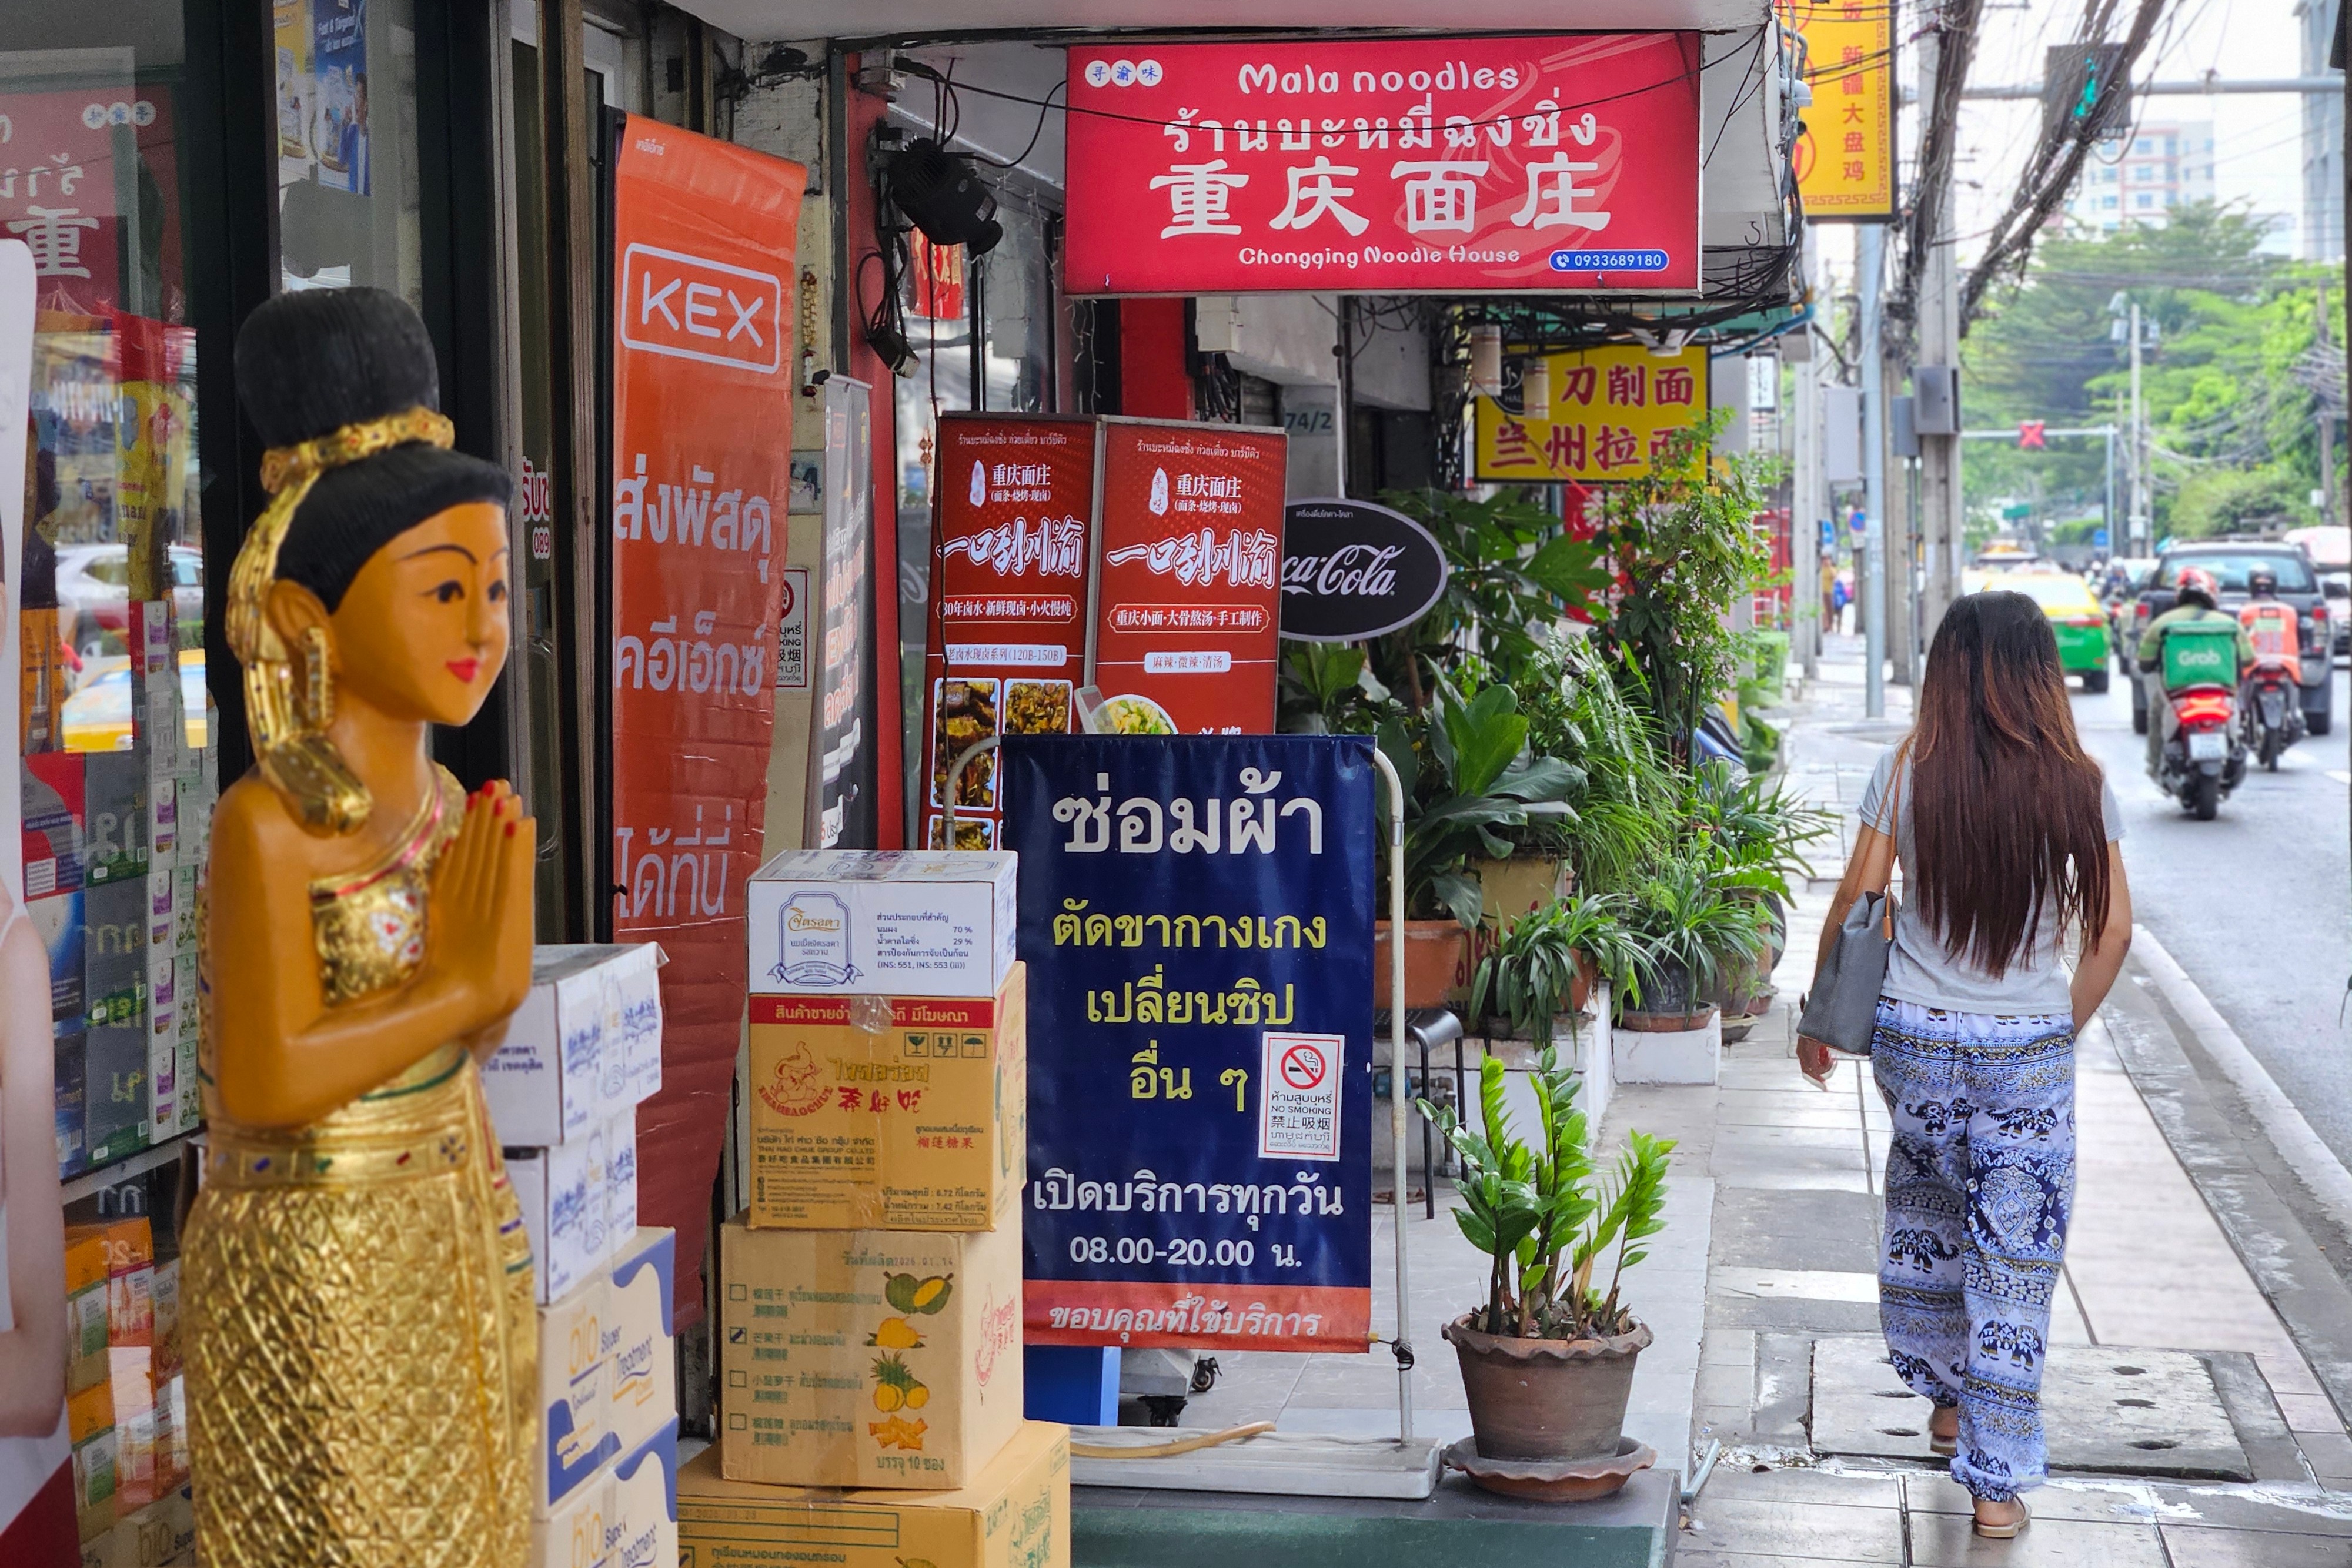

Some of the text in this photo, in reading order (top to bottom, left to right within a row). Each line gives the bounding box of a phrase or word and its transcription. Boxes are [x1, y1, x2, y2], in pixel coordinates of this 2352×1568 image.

[1238, 61, 1519, 94] Mala noodles
[1164, 86, 1597, 152] ร้านบะหมี่ฉงชิ่ง
[1842, 45, 1865, 182] 新疆大盘鸡
[1150, 151, 1611, 239] 重庆面庄
[1363, 246, 1442, 263] Noodle
[1448, 246, 1521, 263] House
[1573, 255, 1663, 268] 0933689180
[641, 270, 764, 349] KEX
[1560, 364, 1695, 407] 刀削面
[1285, 412, 1332, 433] 74/2
[991, 463, 1051, 486] 重庆面庄
[1176, 473, 1242, 499] 重庆面庄
[615, 454, 771, 583] ส่งพัสดุ
[2178, 653, 2221, 666] Grab
[1052, 767, 1323, 854] ซ่อมผ้า
[877, 911, 950, 924] ส่วนประกอบที่สำคัญ
[1052, 898, 1327, 948] ตัดขากางเกง
[898, 961, 914, 969] 551,
[1087, 964, 1294, 1025] เปลี่ยนซิป
[1130, 1039, 1248, 1112] อื่น ๆ
[1271, 1090, 1332, 1106] ห้ามสูบบุหรี่
[1288, 1106, 1332, 1115] SMOKING
[1271, 1116, 1331, 1131] 禁止吸烟
[1033, 1167, 1344, 1232] เปิดบริการทุกวัน
[1069, 1236, 1303, 1268] 08.00-20.00 น.
[908, 1456, 920, 1470] 10
